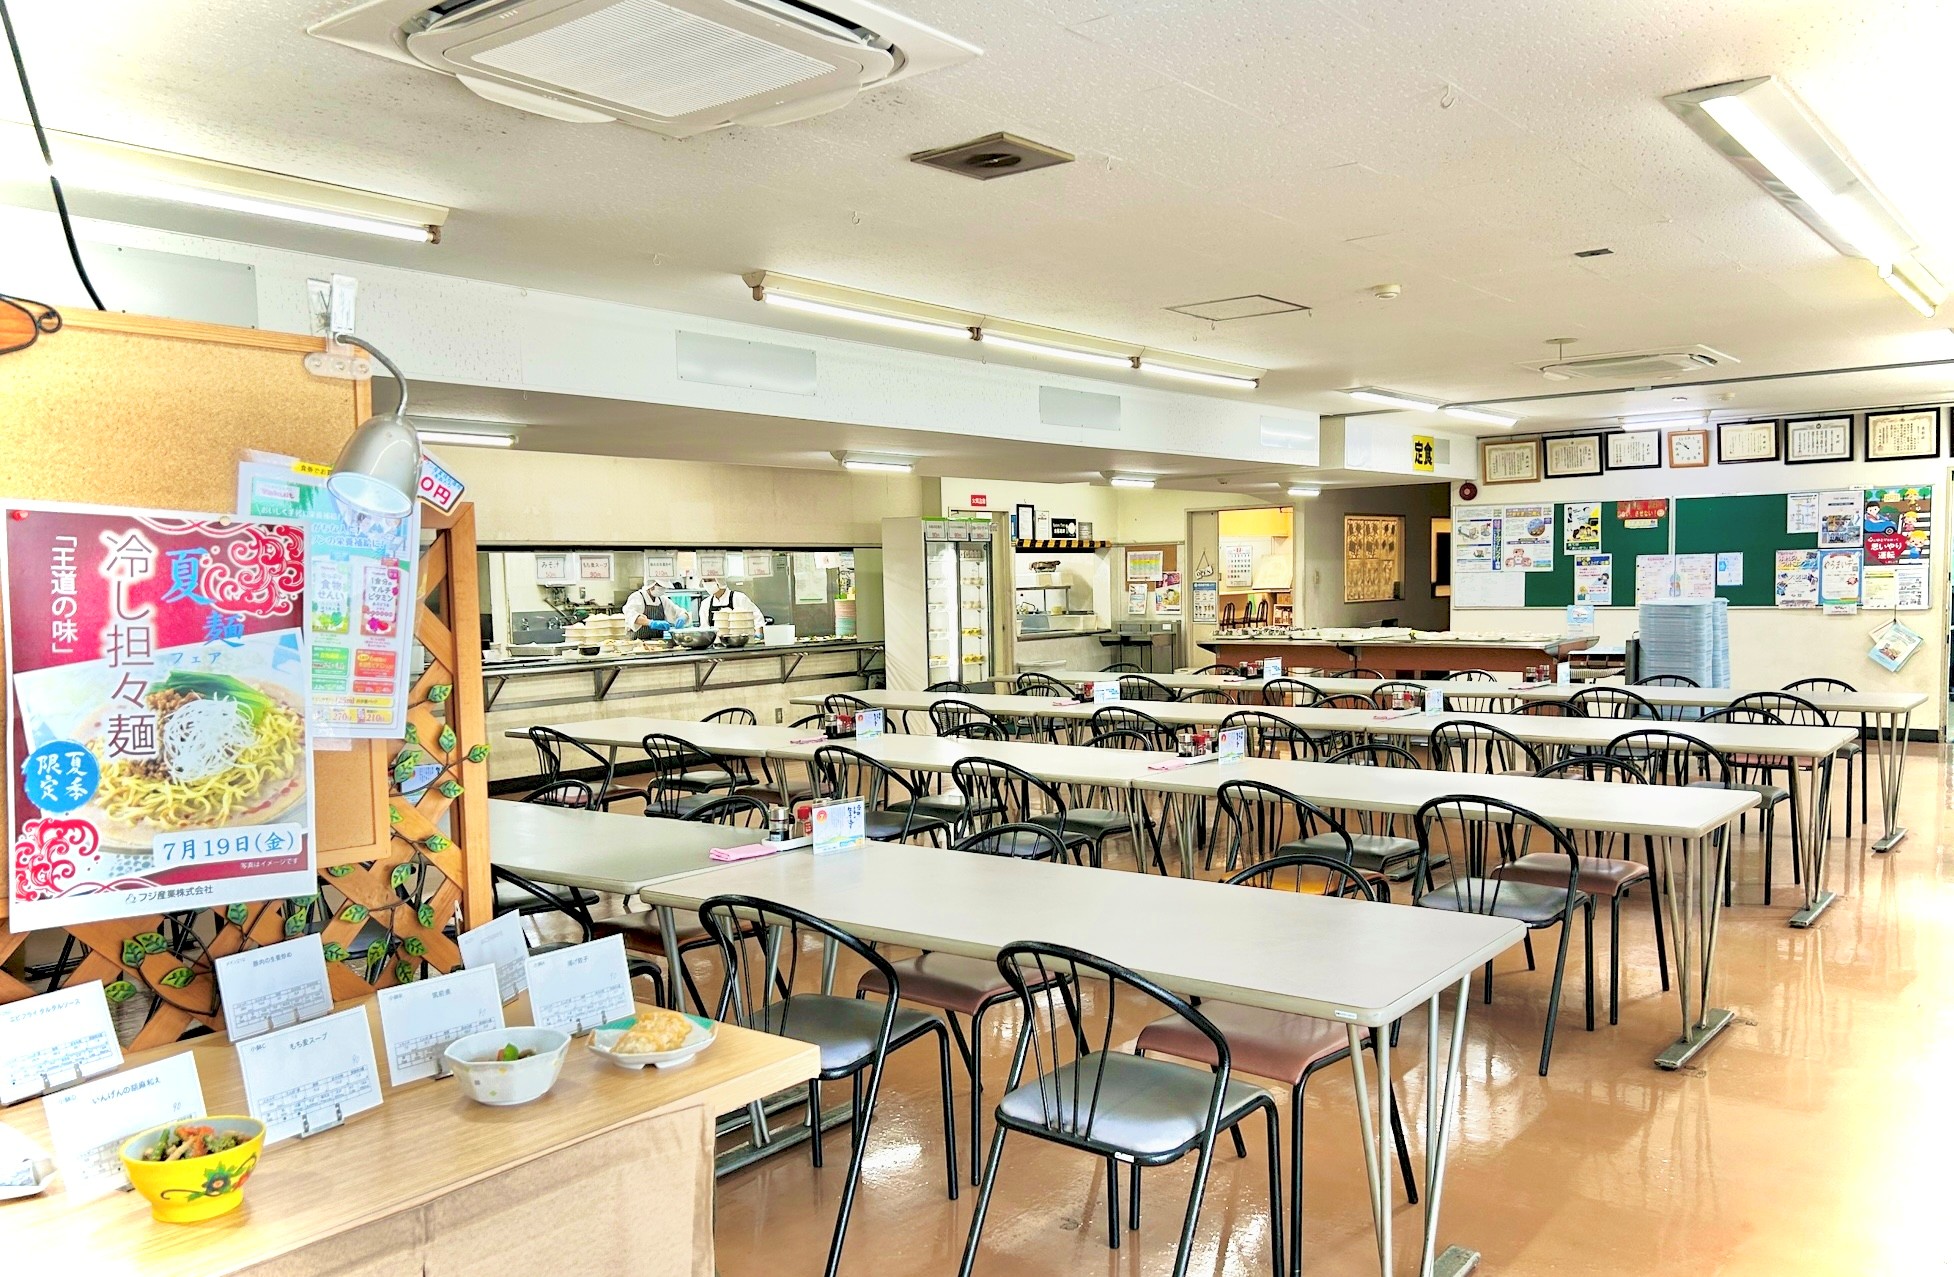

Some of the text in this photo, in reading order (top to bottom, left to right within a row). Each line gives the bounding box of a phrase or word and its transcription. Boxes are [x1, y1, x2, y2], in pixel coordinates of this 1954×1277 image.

[1414, 441, 1433, 466] 定食
[1870, 542, 1902, 551] 思いやり
[1196, 569, 1211, 577] OPEN
[51, 533, 79, 654] 「王道の味」
[103, 531, 158, 759] 冷し担々麺
[171, 651, 222, 666] フェア
[35, 753, 63, 802] 限定
[64, 751, 89, 801] 夏季
[163, 830, 295, 862] 7月19日(金)
[138, 884, 214, 903] フジ産業株式会社
